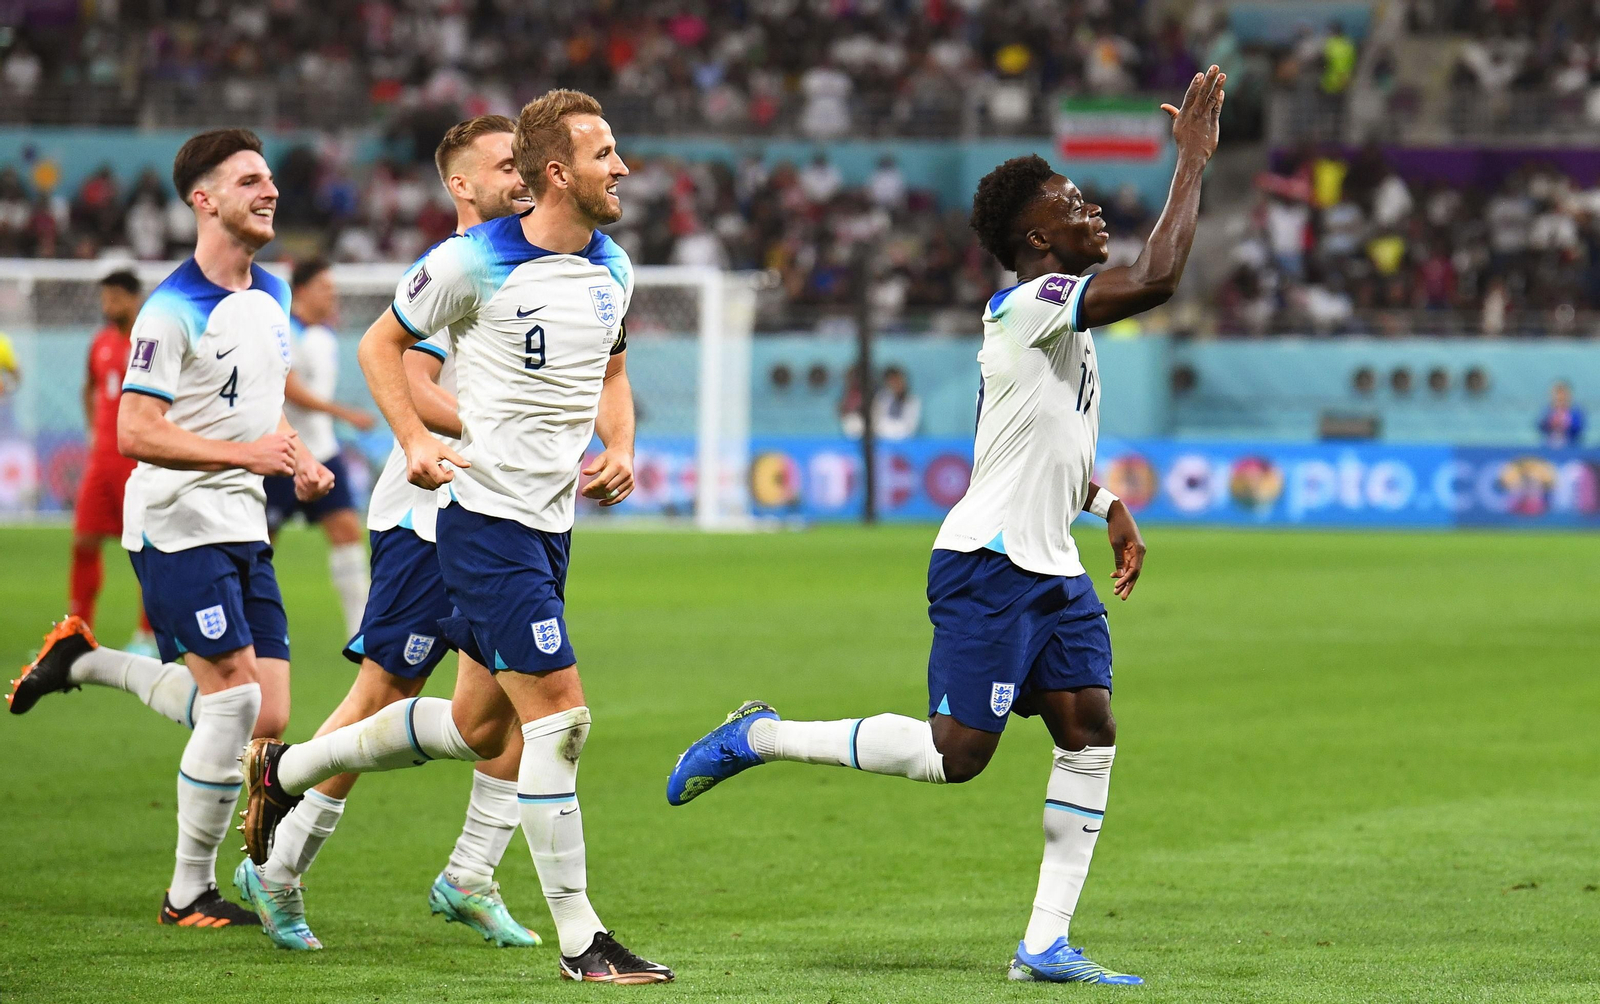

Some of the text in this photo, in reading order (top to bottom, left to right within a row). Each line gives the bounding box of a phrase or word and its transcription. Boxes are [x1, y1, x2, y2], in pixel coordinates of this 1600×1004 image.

[524, 324, 546, 370] 9
[219, 366, 238, 407] 4
[1165, 449, 1594, 521] crpto.com
